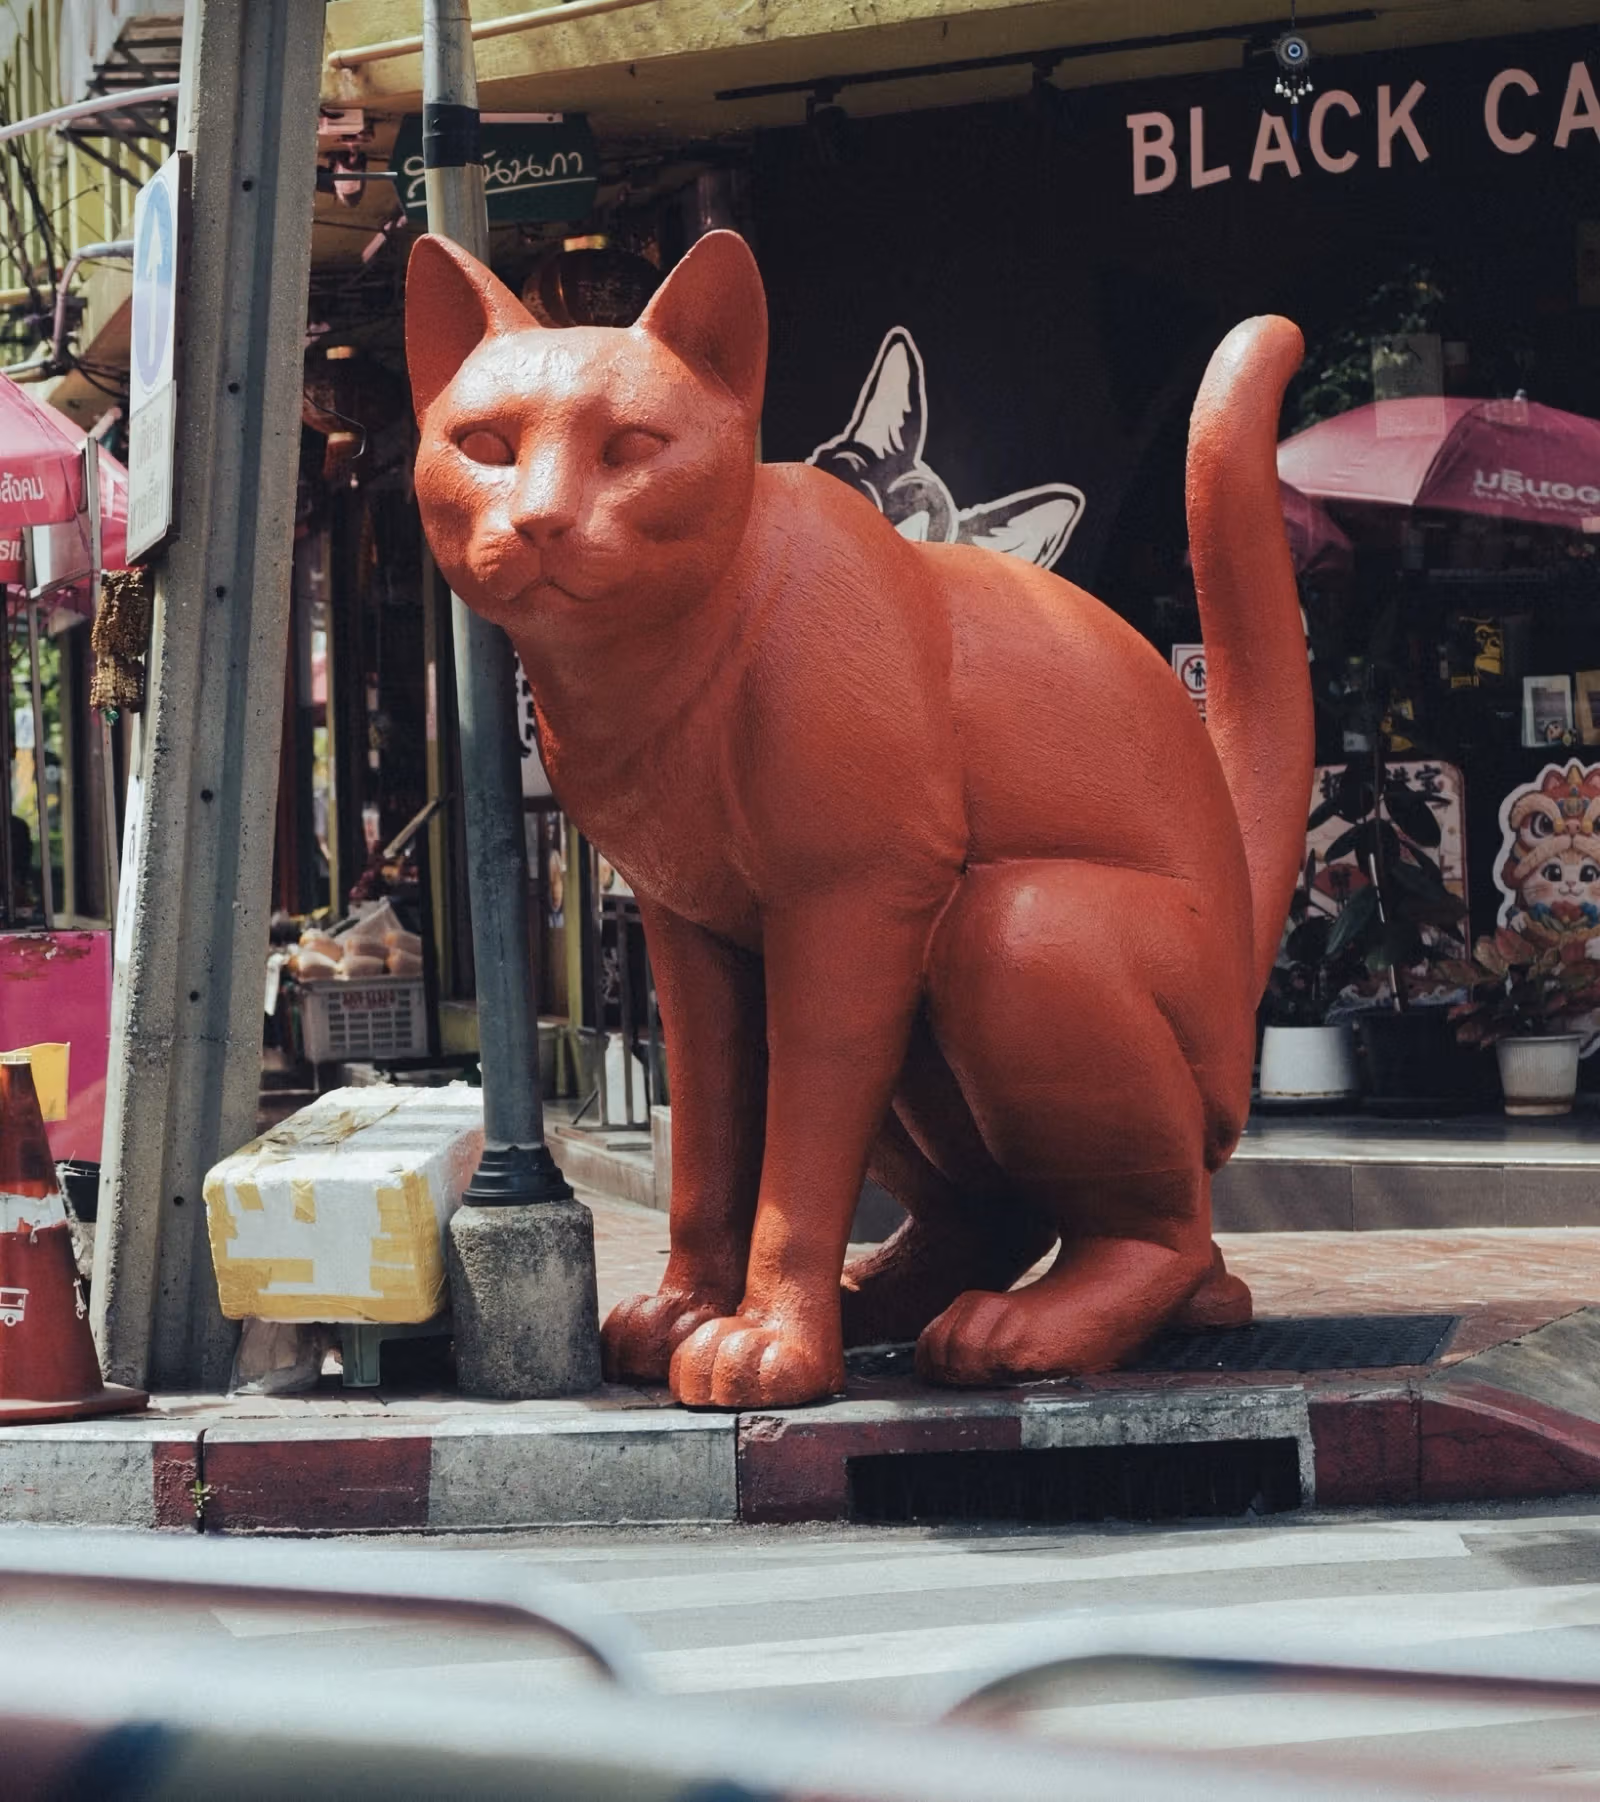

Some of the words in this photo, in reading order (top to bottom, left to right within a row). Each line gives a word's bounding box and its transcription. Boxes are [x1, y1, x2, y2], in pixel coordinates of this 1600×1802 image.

[1126, 79, 1431, 196] BLACK
[1484, 61, 1600, 155] CA
[0, 472, 45, 503] สังคม
